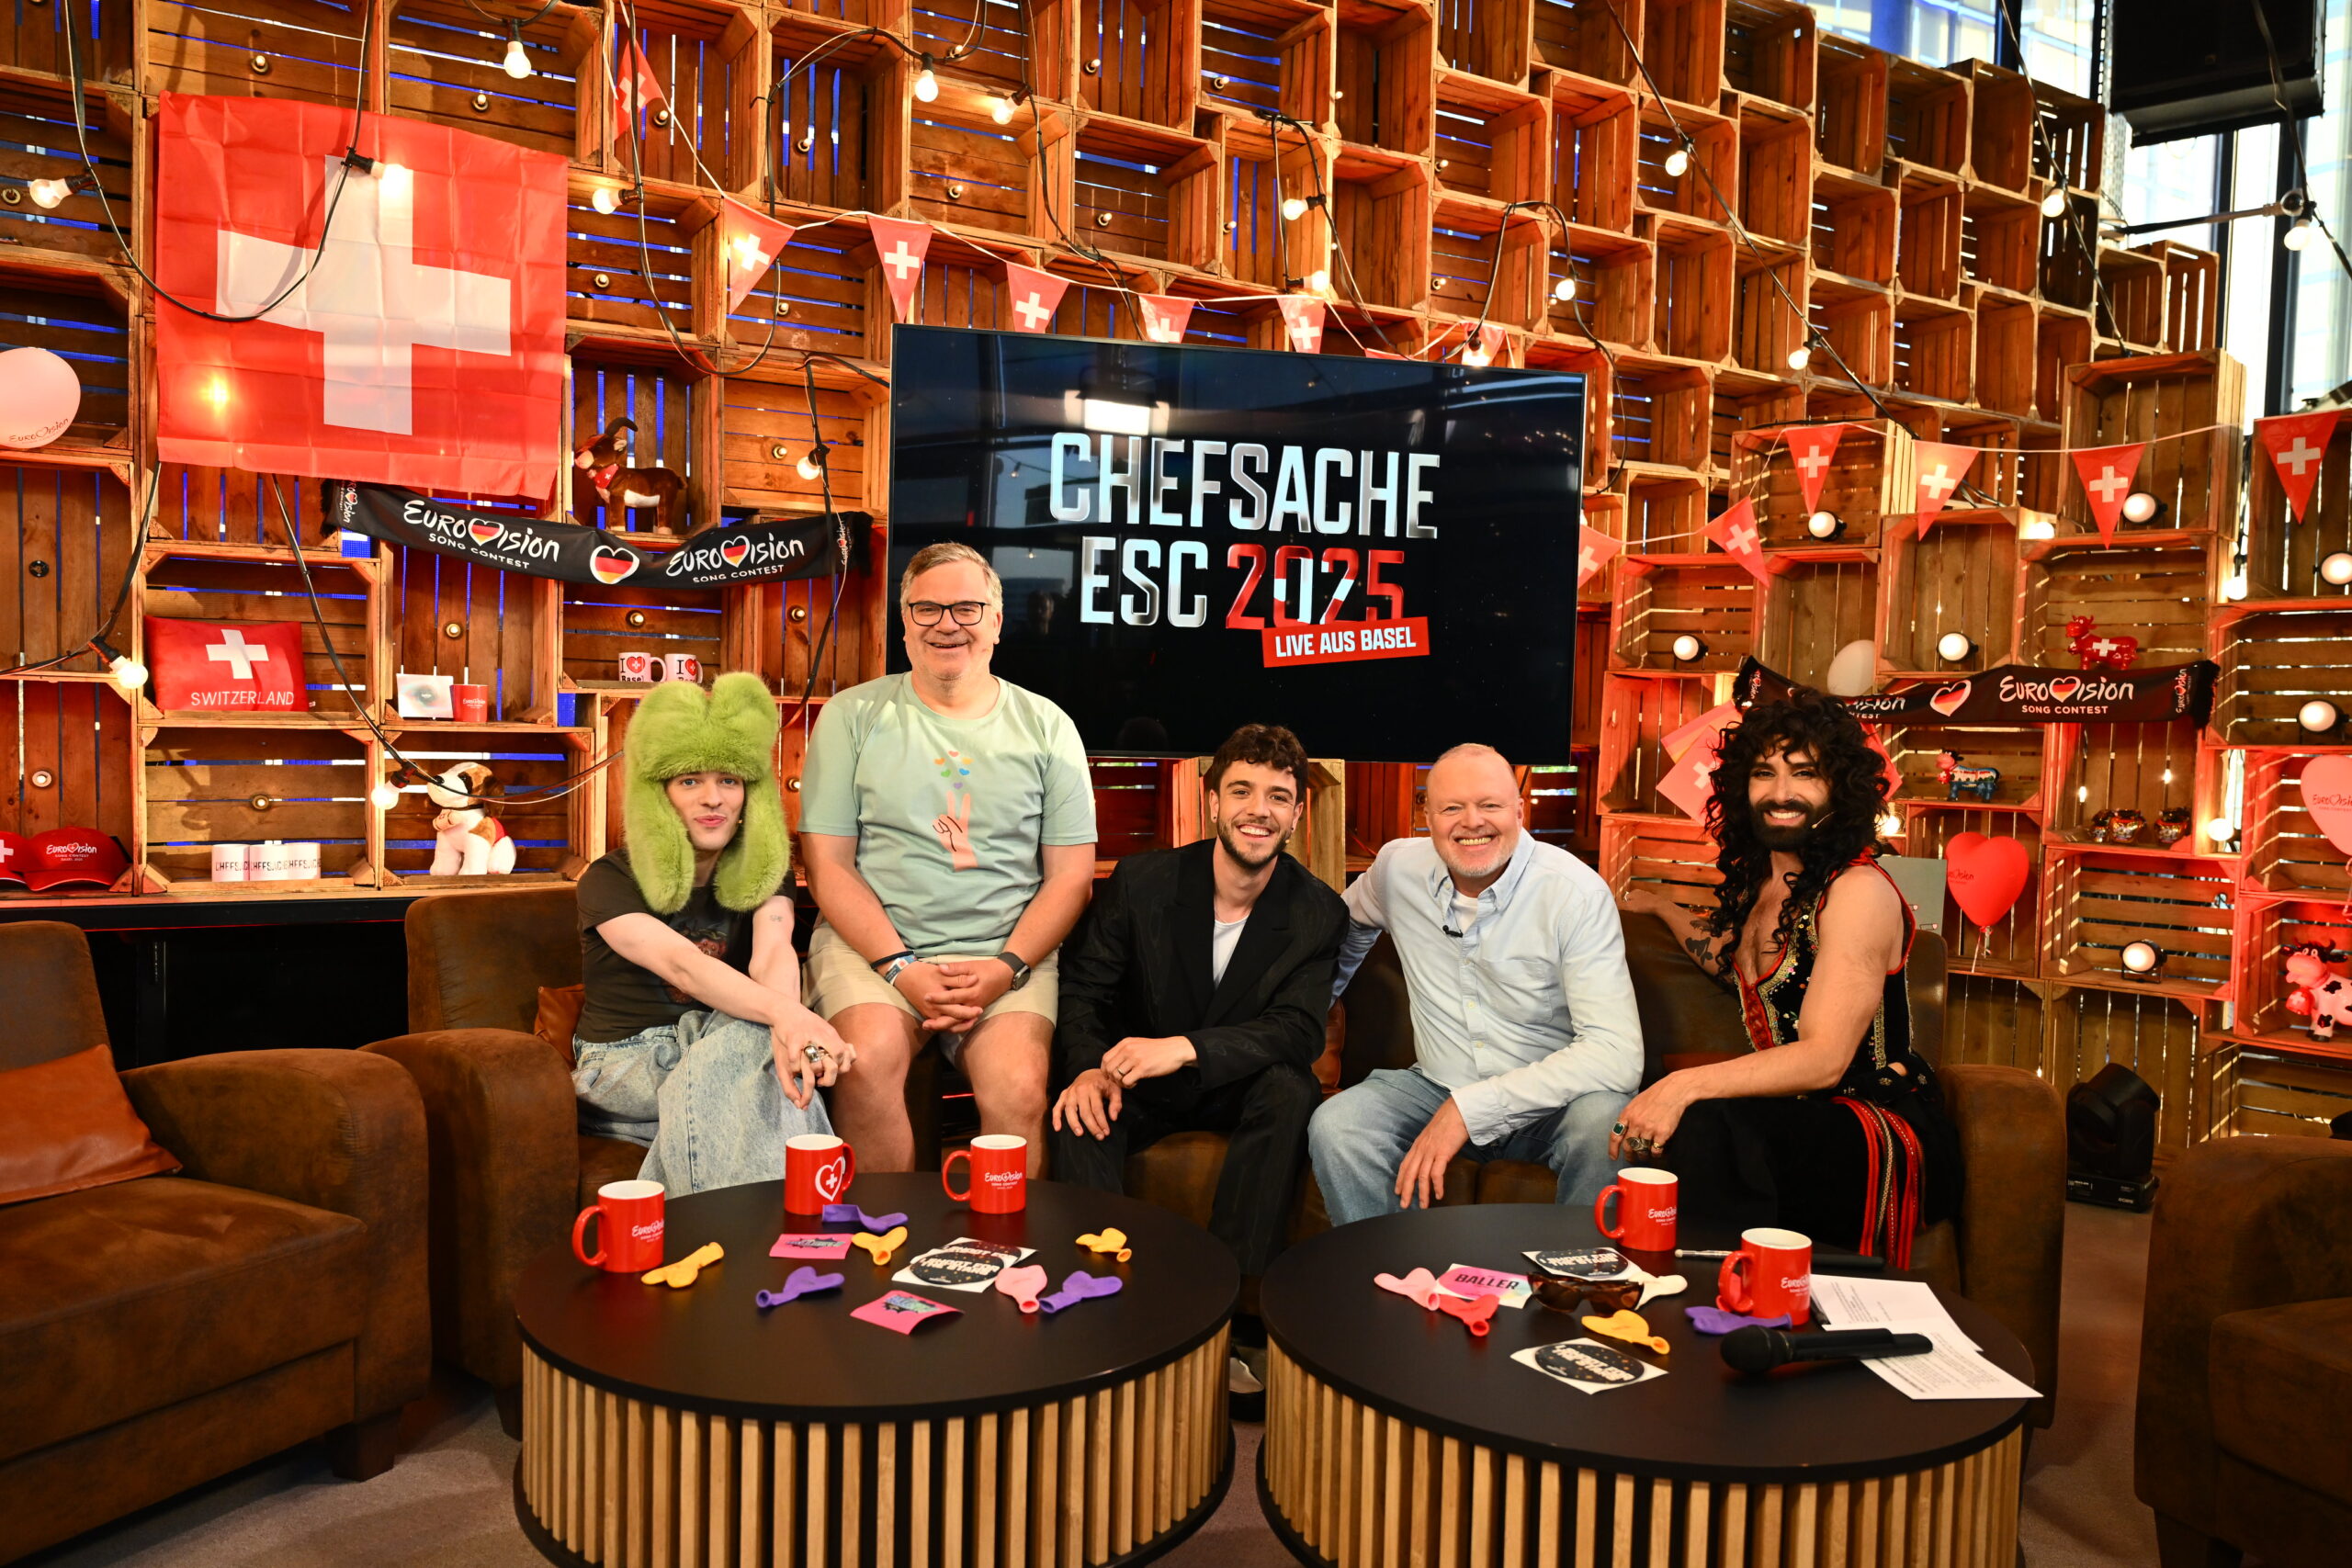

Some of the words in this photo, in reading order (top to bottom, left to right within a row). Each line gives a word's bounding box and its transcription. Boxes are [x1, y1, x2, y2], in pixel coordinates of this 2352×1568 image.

[1049, 432, 1441, 539] CHEFSACHE
[428, 533, 466, 551] SONG
[470, 547, 530, 570] CONTEST
[693, 573, 727, 583] SONG
[730, 564, 785, 579] CONTEST
[1080, 536, 1209, 628] ESC
[1226, 543, 1405, 630] 2025
[1275, 634, 1315, 658] LIVE
[1320, 631, 1355, 654] AUS
[1361, 626, 1417, 651] BASEL
[190, 690, 295, 706] SWITZERLAND
[2021, 705, 2051, 714] SONG
[2054, 705, 2109, 715] CONTEST
[1454, 1273, 1520, 1290] BALLER
